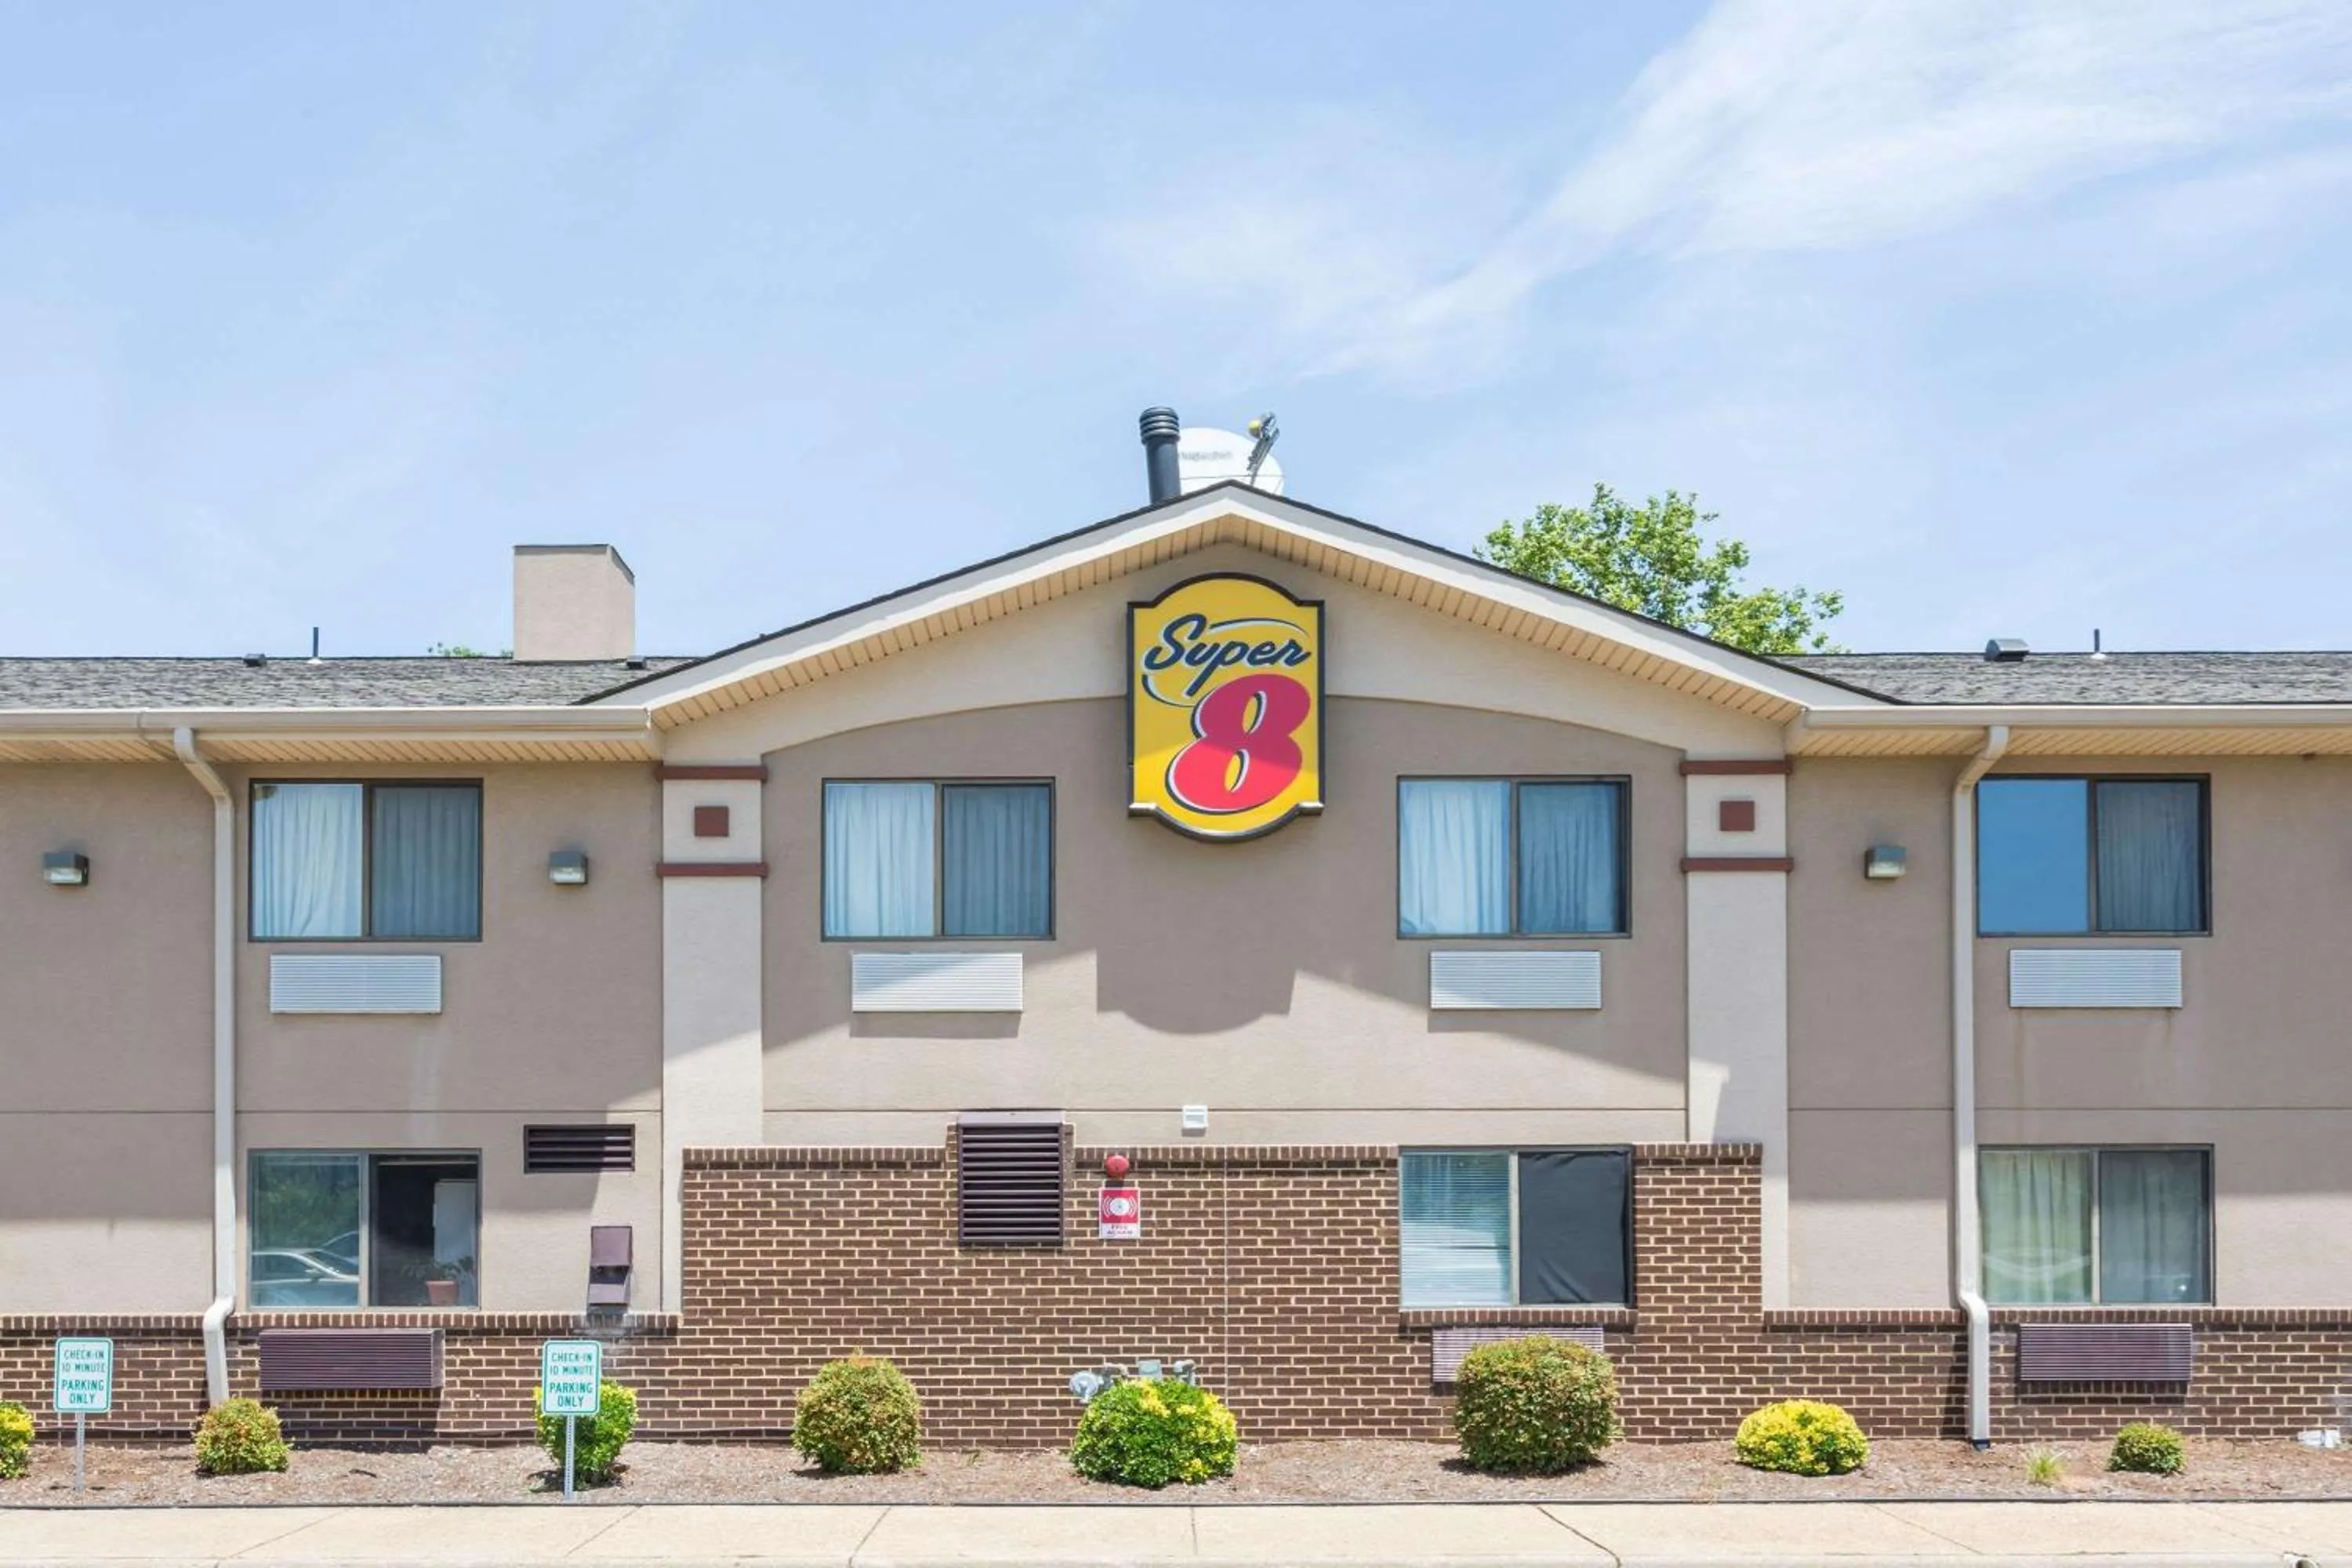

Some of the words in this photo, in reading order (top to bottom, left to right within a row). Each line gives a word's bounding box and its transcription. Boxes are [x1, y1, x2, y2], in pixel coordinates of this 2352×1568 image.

[1142, 613, 1312, 699] Super
[1165, 673, 1311, 815] 8
[62, 1363, 71, 1372] 10
[74, 1363, 105, 1373] MINUTE
[550, 1366, 558, 1374] 10
[562, 1366, 593, 1374] MINUTE
[62, 1379, 104, 1391] PARKING
[550, 1382, 593, 1393] PARKING
[69, 1393, 95, 1403] ONLY
[557, 1396, 584, 1406] ONLY
